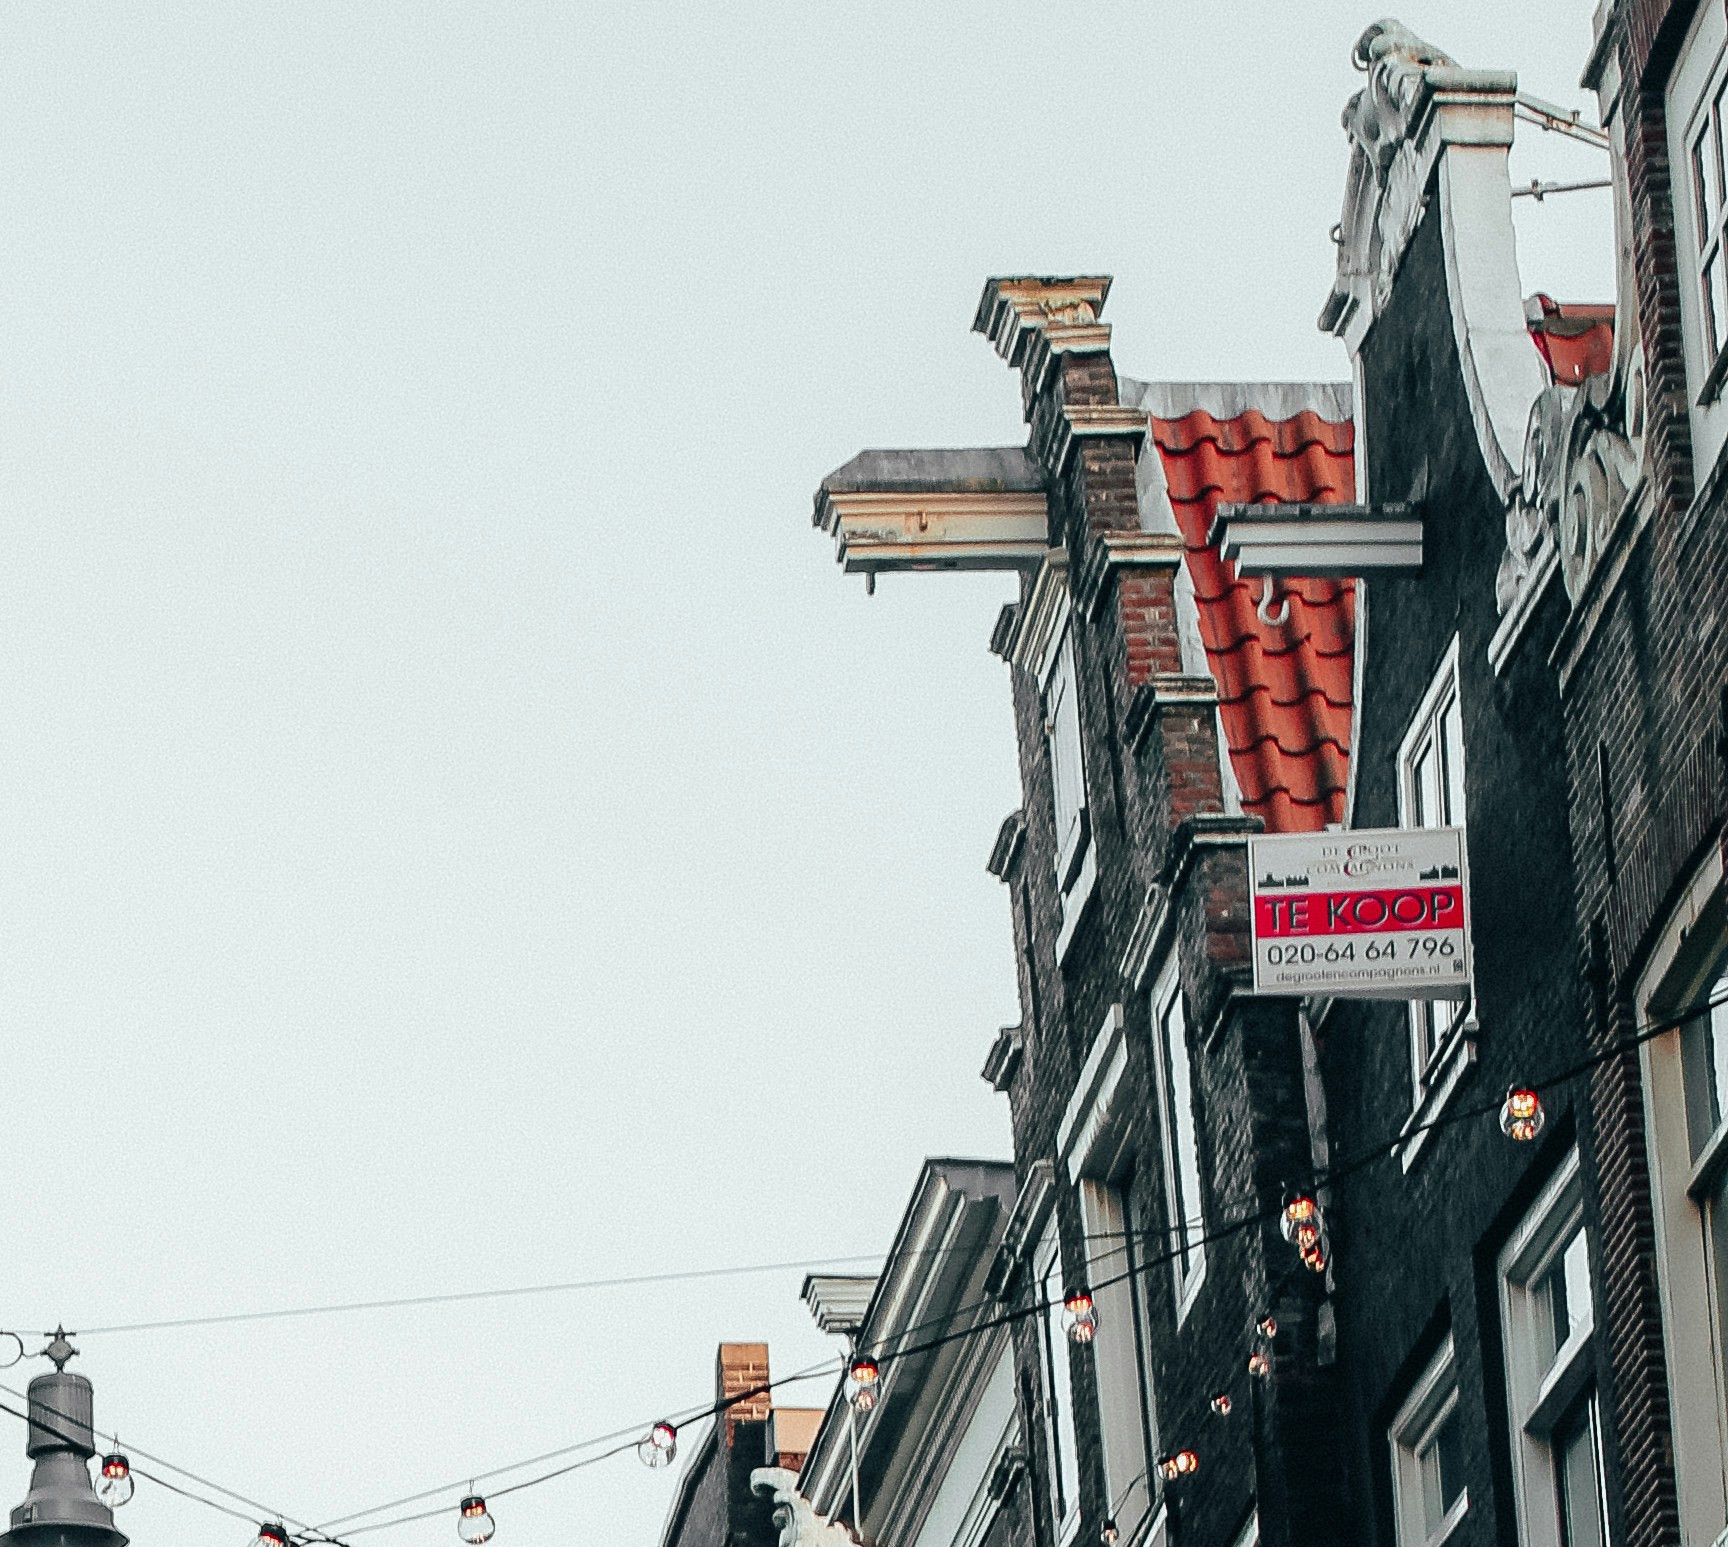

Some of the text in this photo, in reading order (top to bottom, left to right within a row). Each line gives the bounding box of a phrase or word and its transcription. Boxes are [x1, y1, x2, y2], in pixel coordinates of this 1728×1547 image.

[1265, 891, 1455, 934] TE KOOP
[1267, 935, 1456, 966] 020-64 64 796
